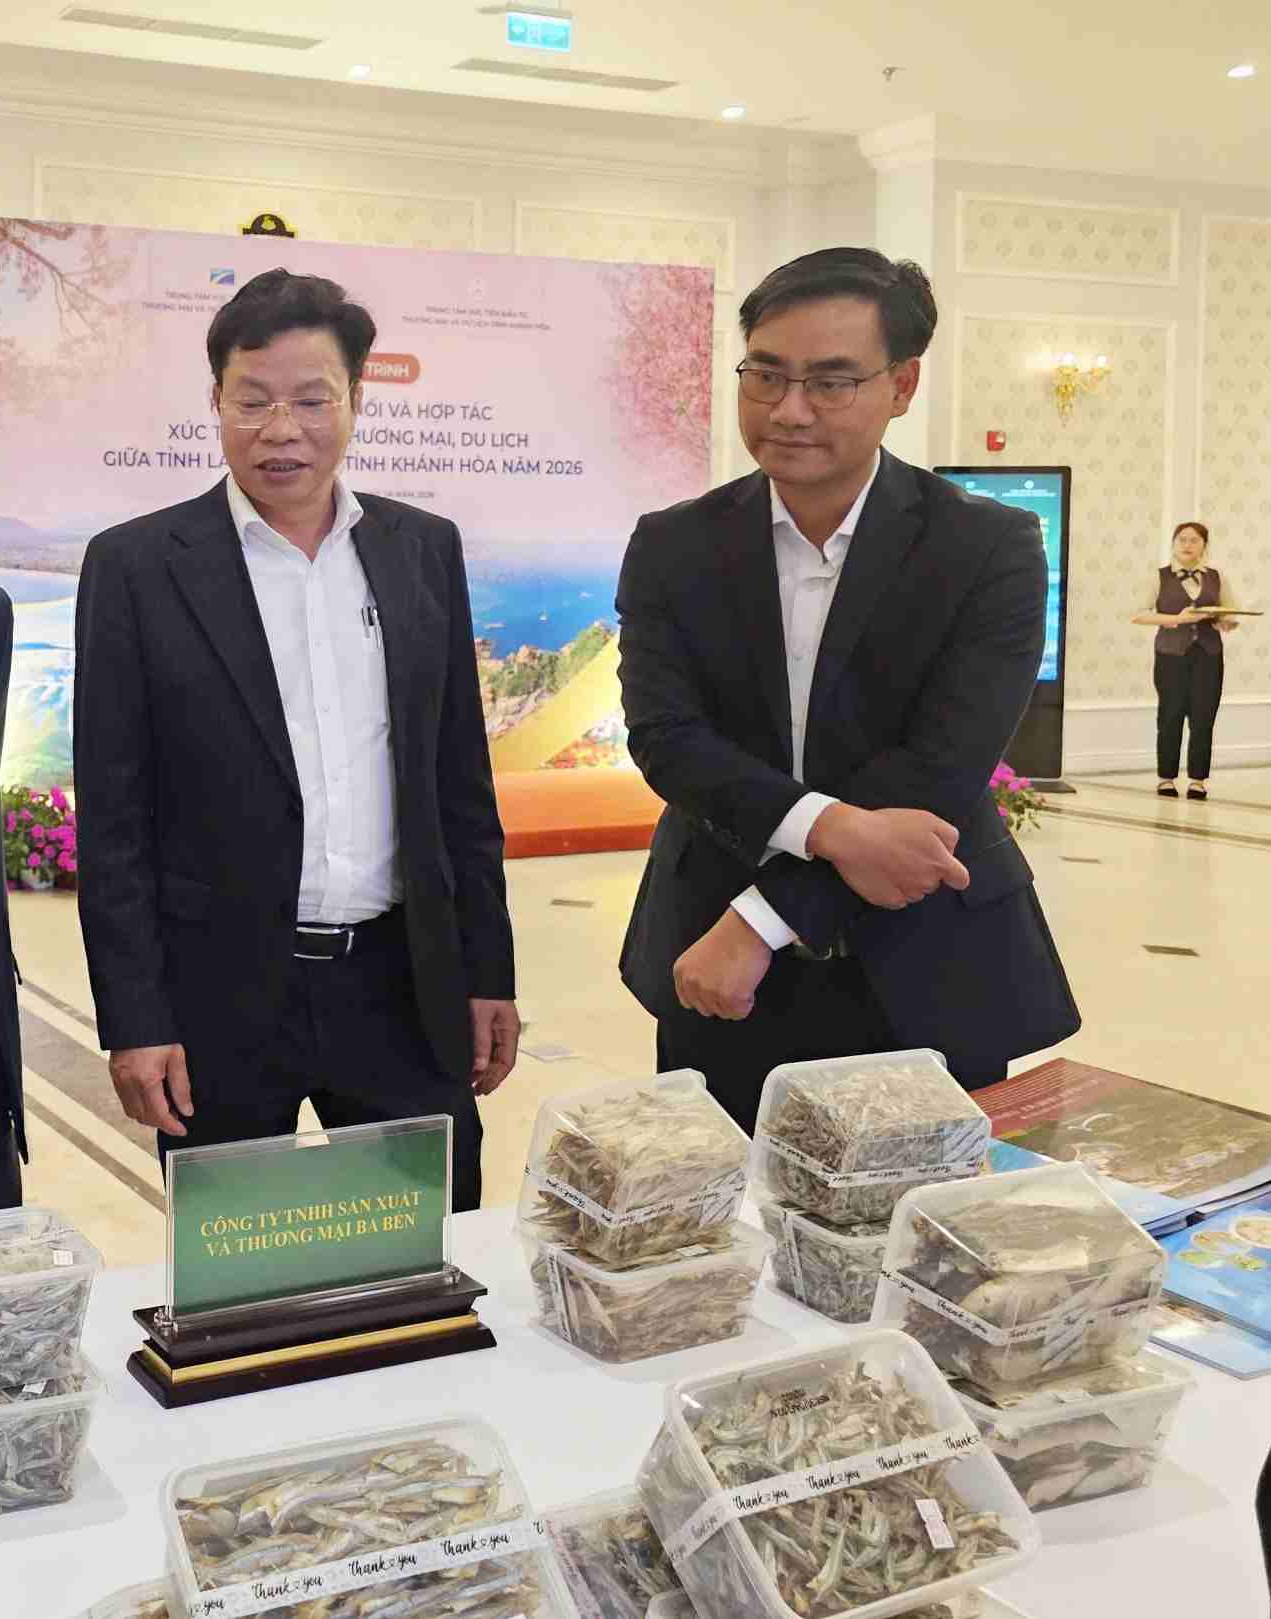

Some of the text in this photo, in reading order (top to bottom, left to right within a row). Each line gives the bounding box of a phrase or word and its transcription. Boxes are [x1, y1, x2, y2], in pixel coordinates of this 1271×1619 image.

[366, 361, 410, 377] TRÌNH
[364, 396, 493, 423] ỐI VÀ HỢP TÁC
[168, 418, 208, 441] XÚC
[420, 432, 456, 450] MẠI,
[461, 432, 486, 447] DU
[491, 433, 529, 452] LỊCH
[103, 447, 151, 467] GIỮA
[155, 446, 201, 468] TỈNH
[346, 450, 584, 475] TỈNH KHÁNH HÒA NĂM 2026
[200, 1215, 252, 1238] CÔNG
[258, 1209, 281, 1229] TY
[283, 1203, 334, 1224] TNHH
[205, 1238, 232, 1257] VÀ
[234, 1227, 314, 1253] THƯƠNG
[317, 1221, 352, 1243] MẠI
[488, 1532, 510, 1551] you
[393, 1552, 418, 1571] you
[301, 1575, 324, 1593] you
[202, 1598, 227, 1616] you
